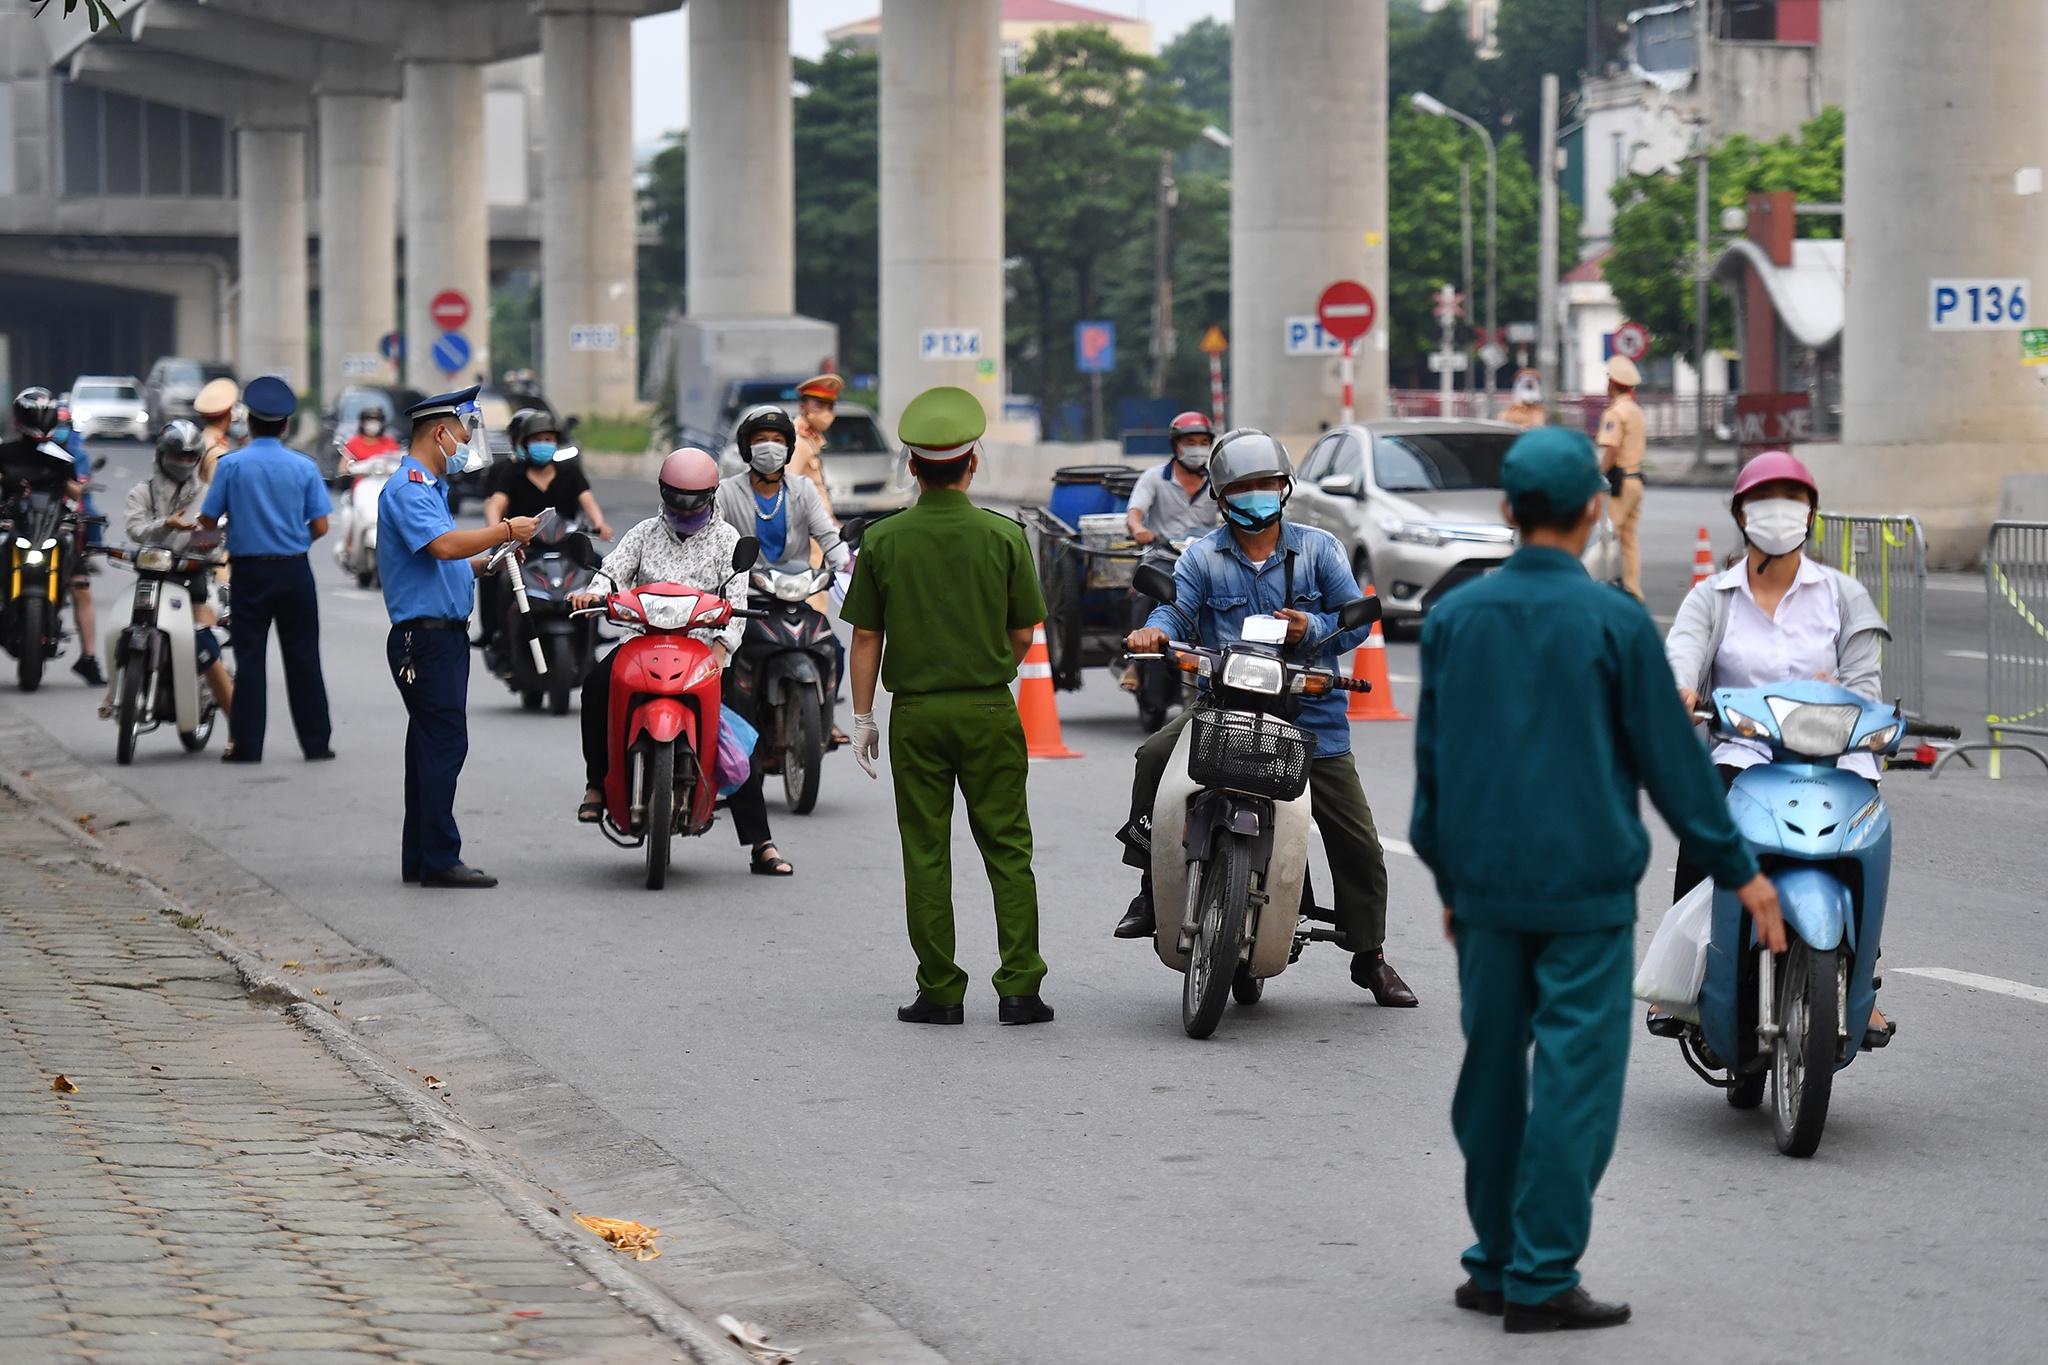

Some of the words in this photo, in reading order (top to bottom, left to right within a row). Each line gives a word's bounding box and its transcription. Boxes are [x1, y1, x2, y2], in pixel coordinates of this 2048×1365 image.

[1935, 285, 2025, 323] P136
[923, 333, 979, 354] P134
[1790, 778, 1829, 786] HONDA
